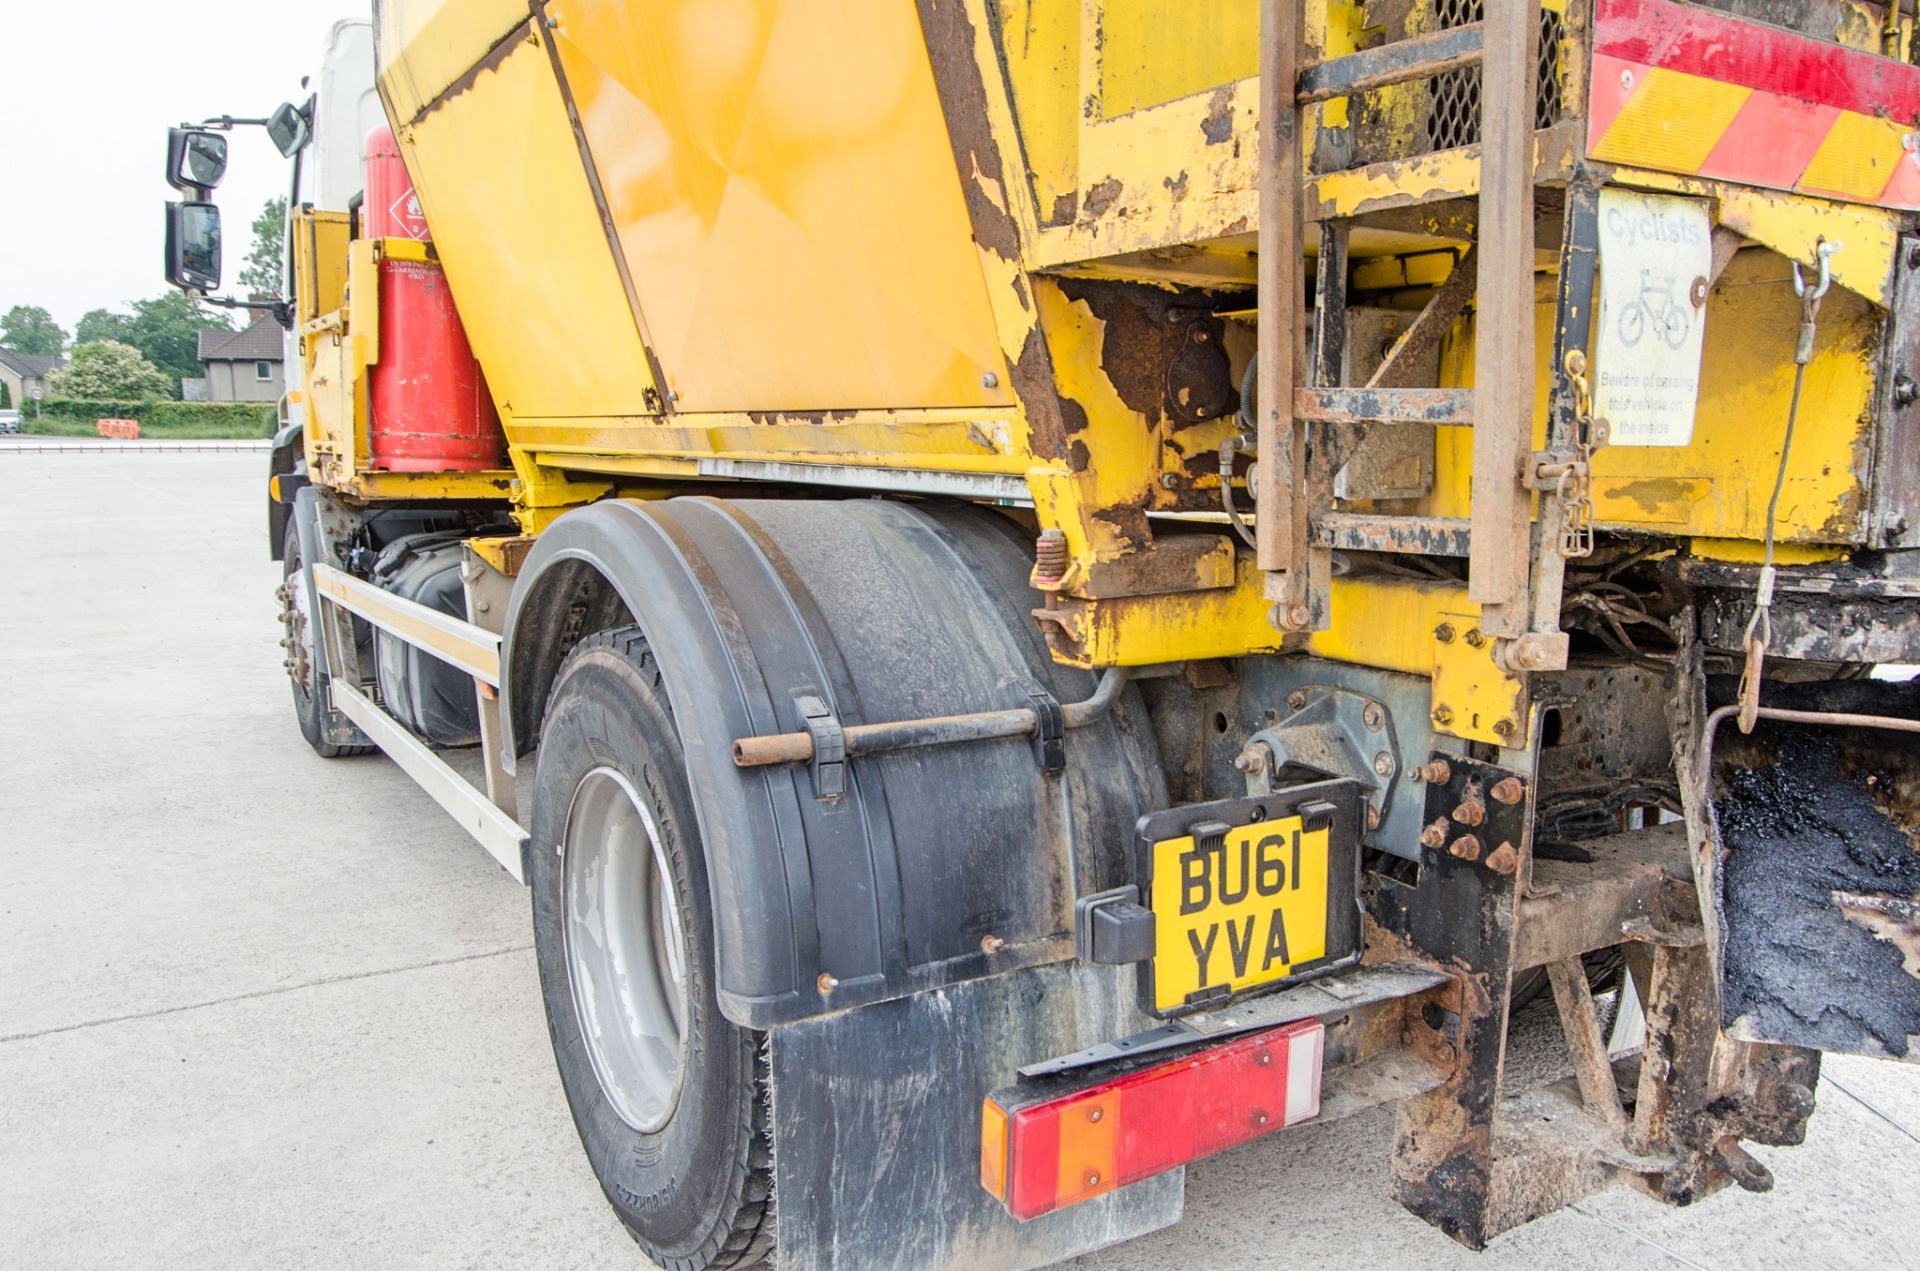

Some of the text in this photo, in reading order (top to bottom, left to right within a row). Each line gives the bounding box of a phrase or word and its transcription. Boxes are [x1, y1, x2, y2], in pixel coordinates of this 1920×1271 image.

[1606, 207, 1701, 247] Cyclists
[1601, 371, 1694, 392] Beware of passing
[1608, 396, 1683, 411] this vehicle on
[1619, 420, 1670, 434] the inside
[1179, 829, 1301, 916] BU61
[1187, 907, 1290, 988] YVA
